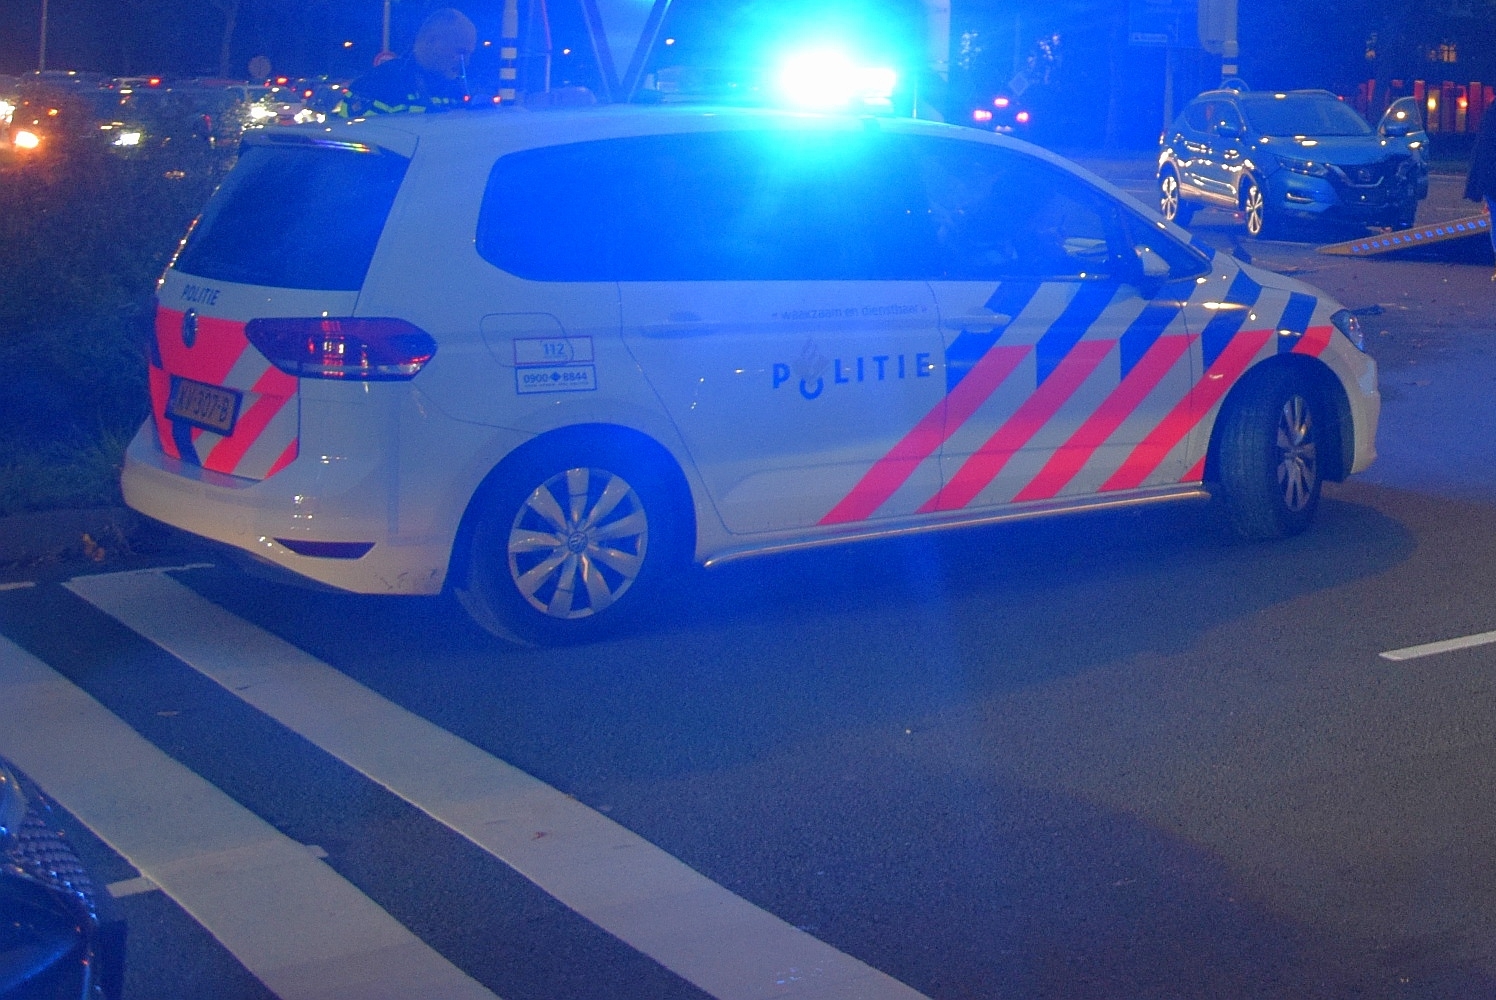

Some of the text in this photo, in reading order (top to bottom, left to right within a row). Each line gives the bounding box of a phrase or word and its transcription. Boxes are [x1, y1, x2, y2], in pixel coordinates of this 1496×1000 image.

[181, 284, 221, 306] POLITIE
[543, 343, 565, 355] 112
[523, 373, 548, 384] 0900
[563, 371, 587, 382] 8844
